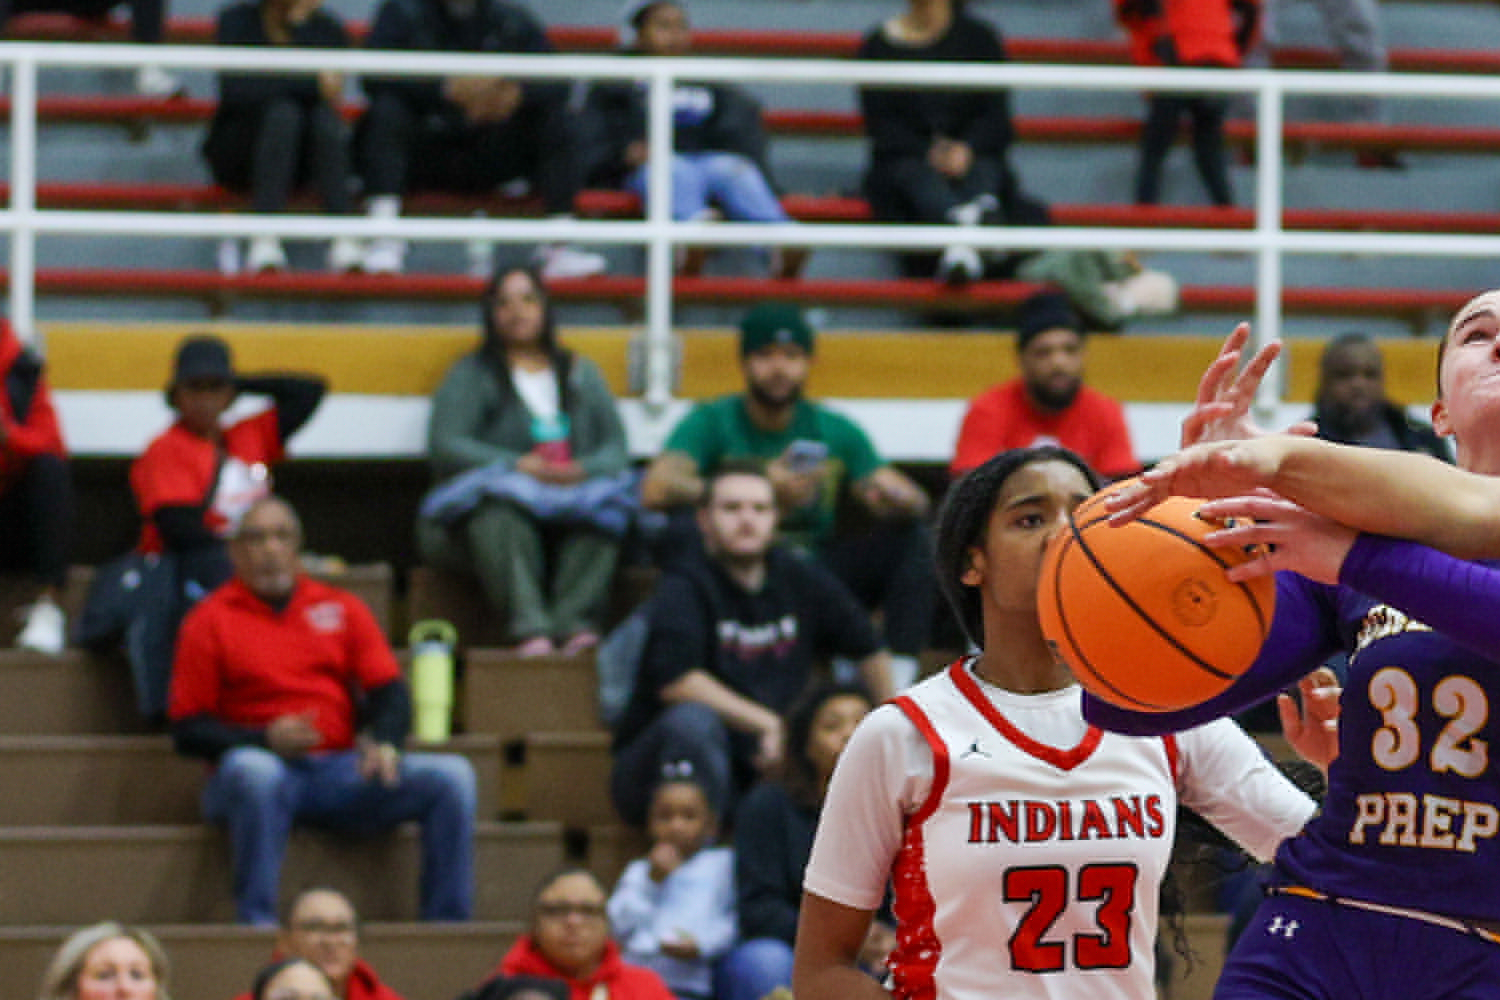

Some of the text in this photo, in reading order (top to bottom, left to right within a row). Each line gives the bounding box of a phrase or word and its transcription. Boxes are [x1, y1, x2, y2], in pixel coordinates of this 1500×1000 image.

[1368, 666, 1489, 779] 32
[967, 794, 1165, 844] INDIANS
[1349, 792, 1500, 854] PREP
[1002, 862, 1139, 973] 23
